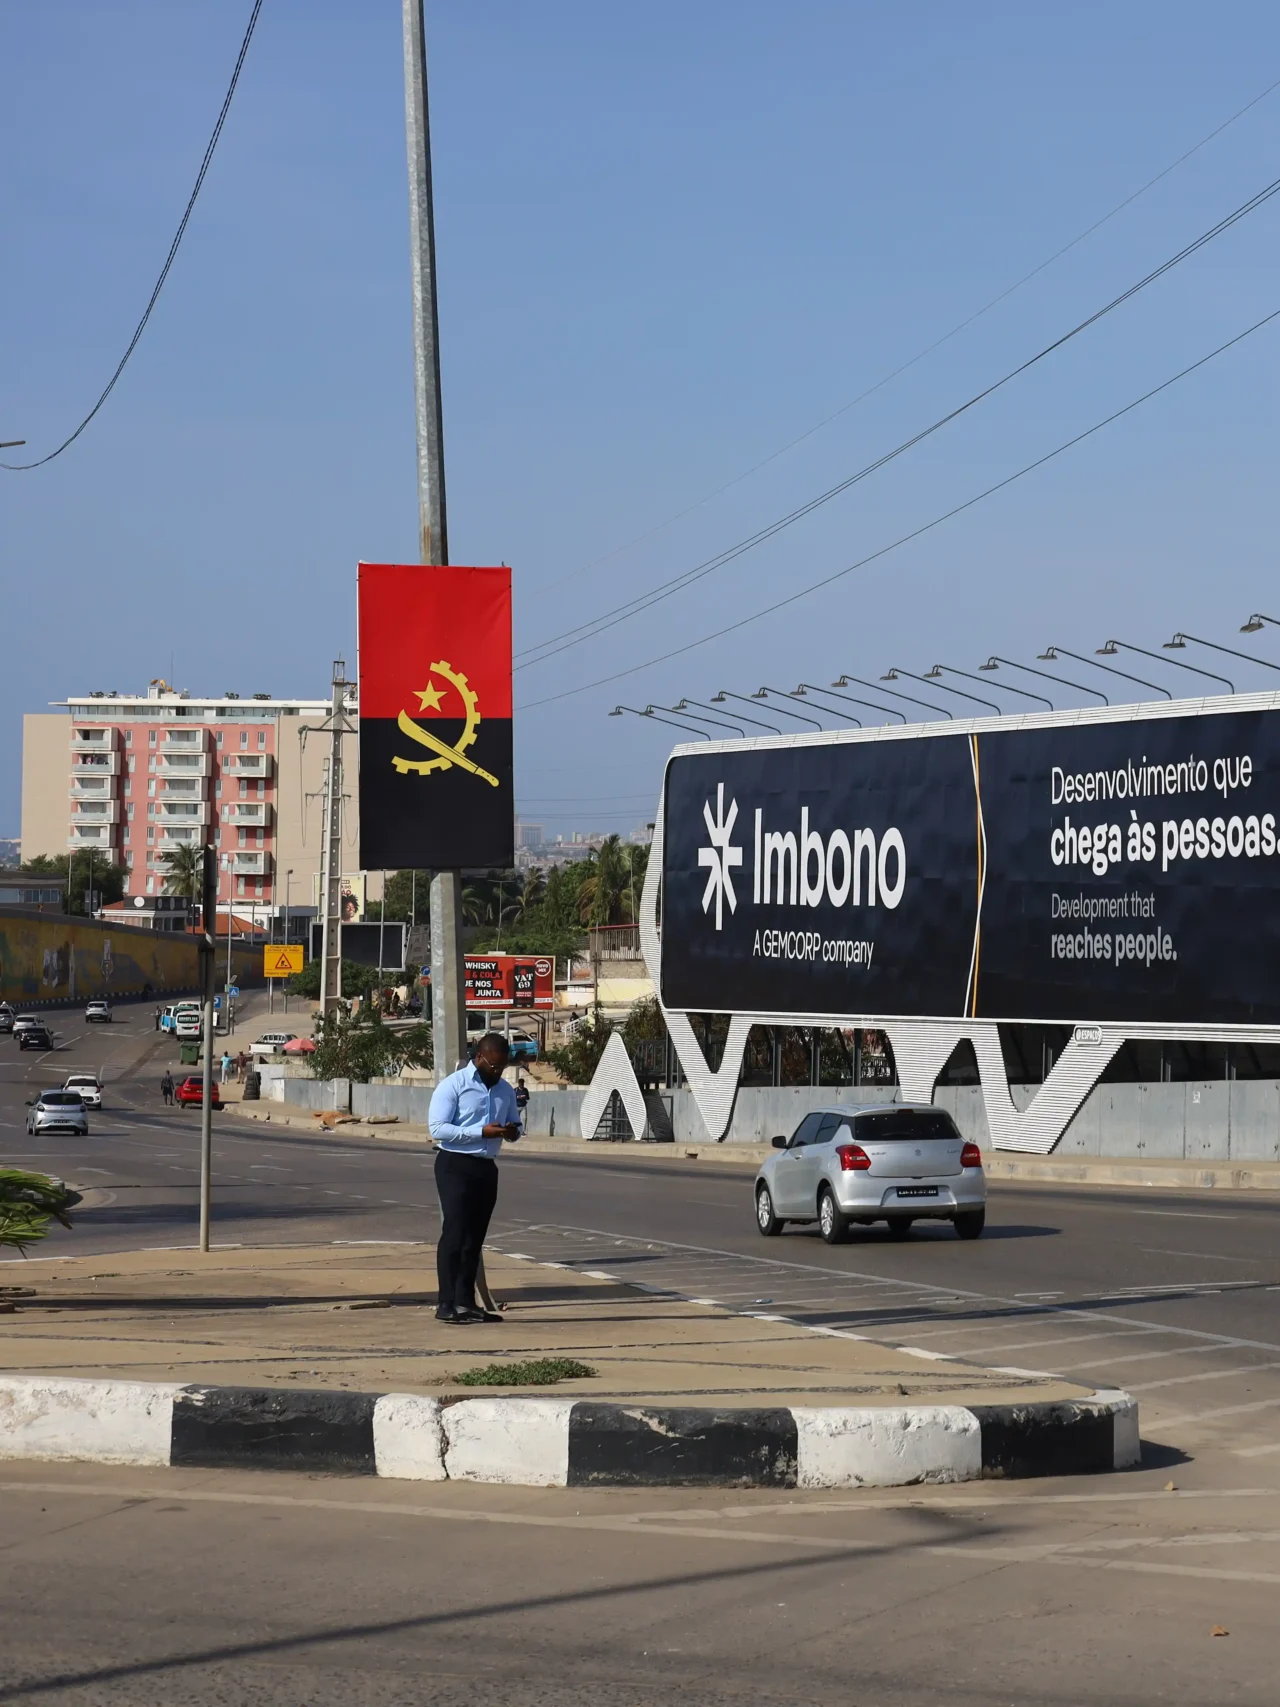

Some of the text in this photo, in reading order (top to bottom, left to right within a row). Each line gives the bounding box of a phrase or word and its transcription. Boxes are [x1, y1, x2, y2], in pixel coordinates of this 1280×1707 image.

[1051, 753, 1252, 804] Desenvolvimento que
[753, 806, 906, 909] Imbono
[1051, 816, 1122, 876] chega
[1127, 809, 1156, 861] às
[1051, 891, 1155, 923] Development that
[753, 929, 874, 970] A GEMCORP company
[1051, 926, 1177, 967] reaches people.
[475, 980, 492, 988] NOS
[515, 973, 533, 982] VAT
